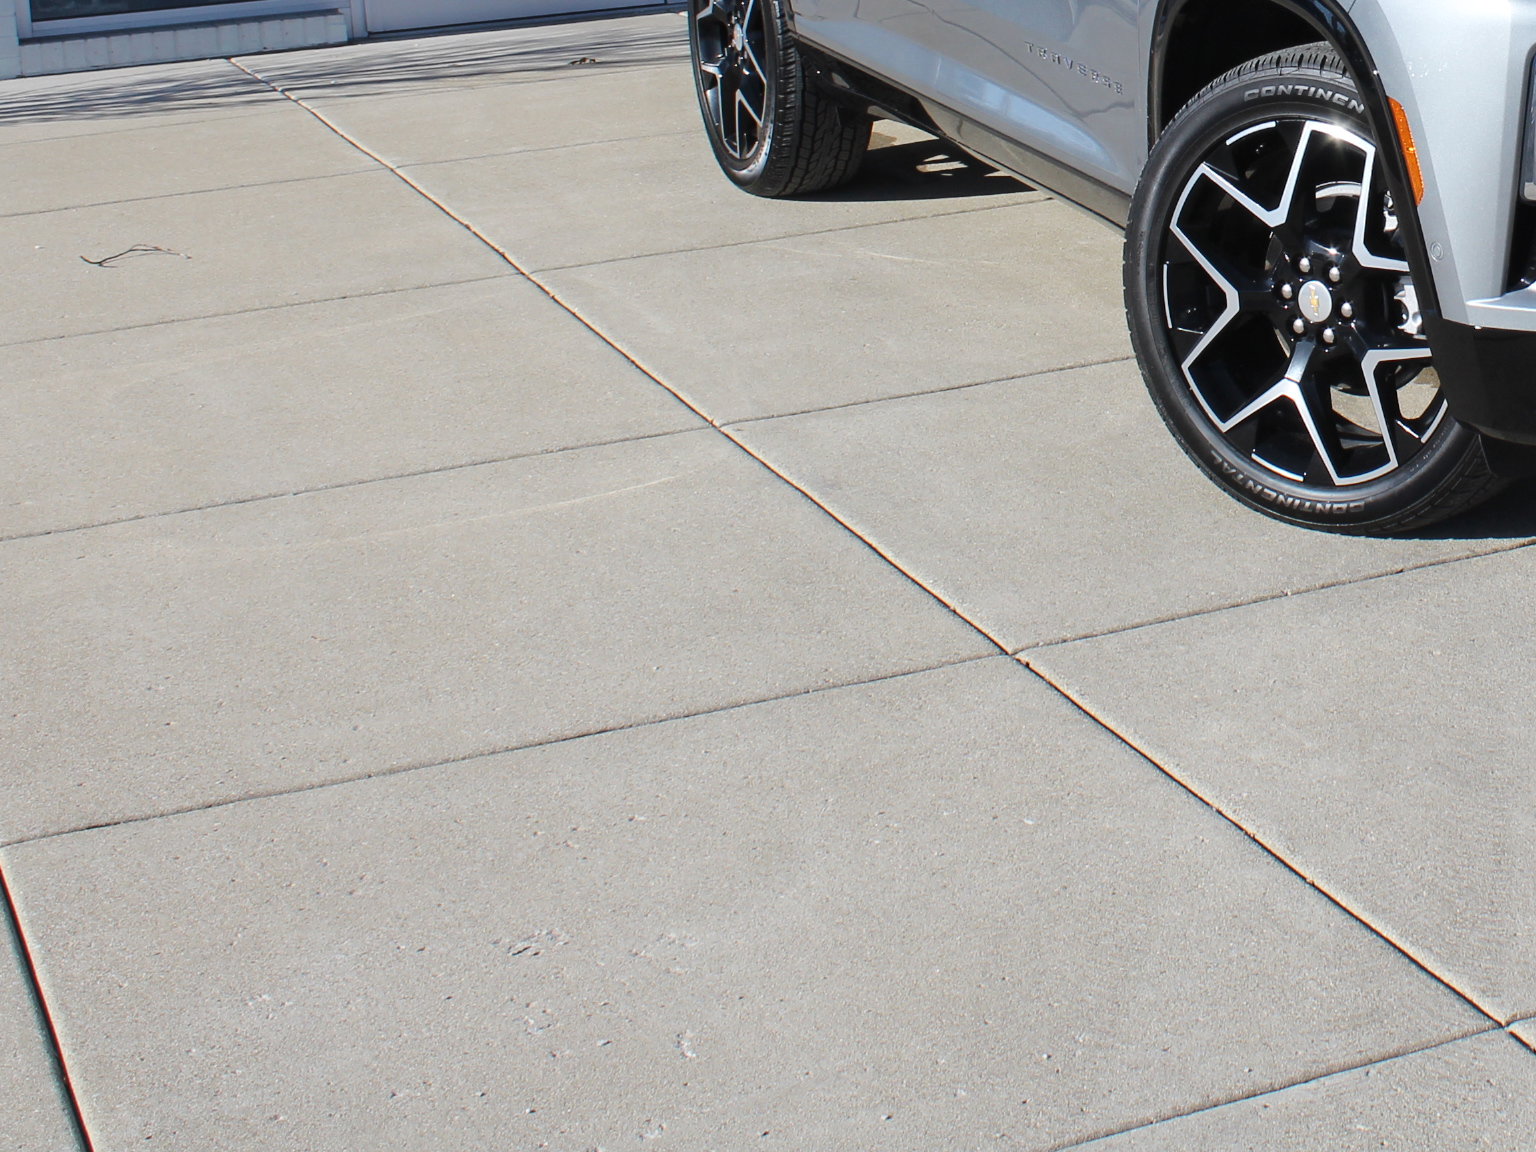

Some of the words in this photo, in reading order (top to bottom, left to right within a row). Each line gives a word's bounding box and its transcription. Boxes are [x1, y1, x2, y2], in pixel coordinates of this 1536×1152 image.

[1024, 41, 1123, 95] TRAVERSE
[1243, 84, 1365, 114] CONTINEN
[1210, 449, 1365, 514] CONTINENTAL
